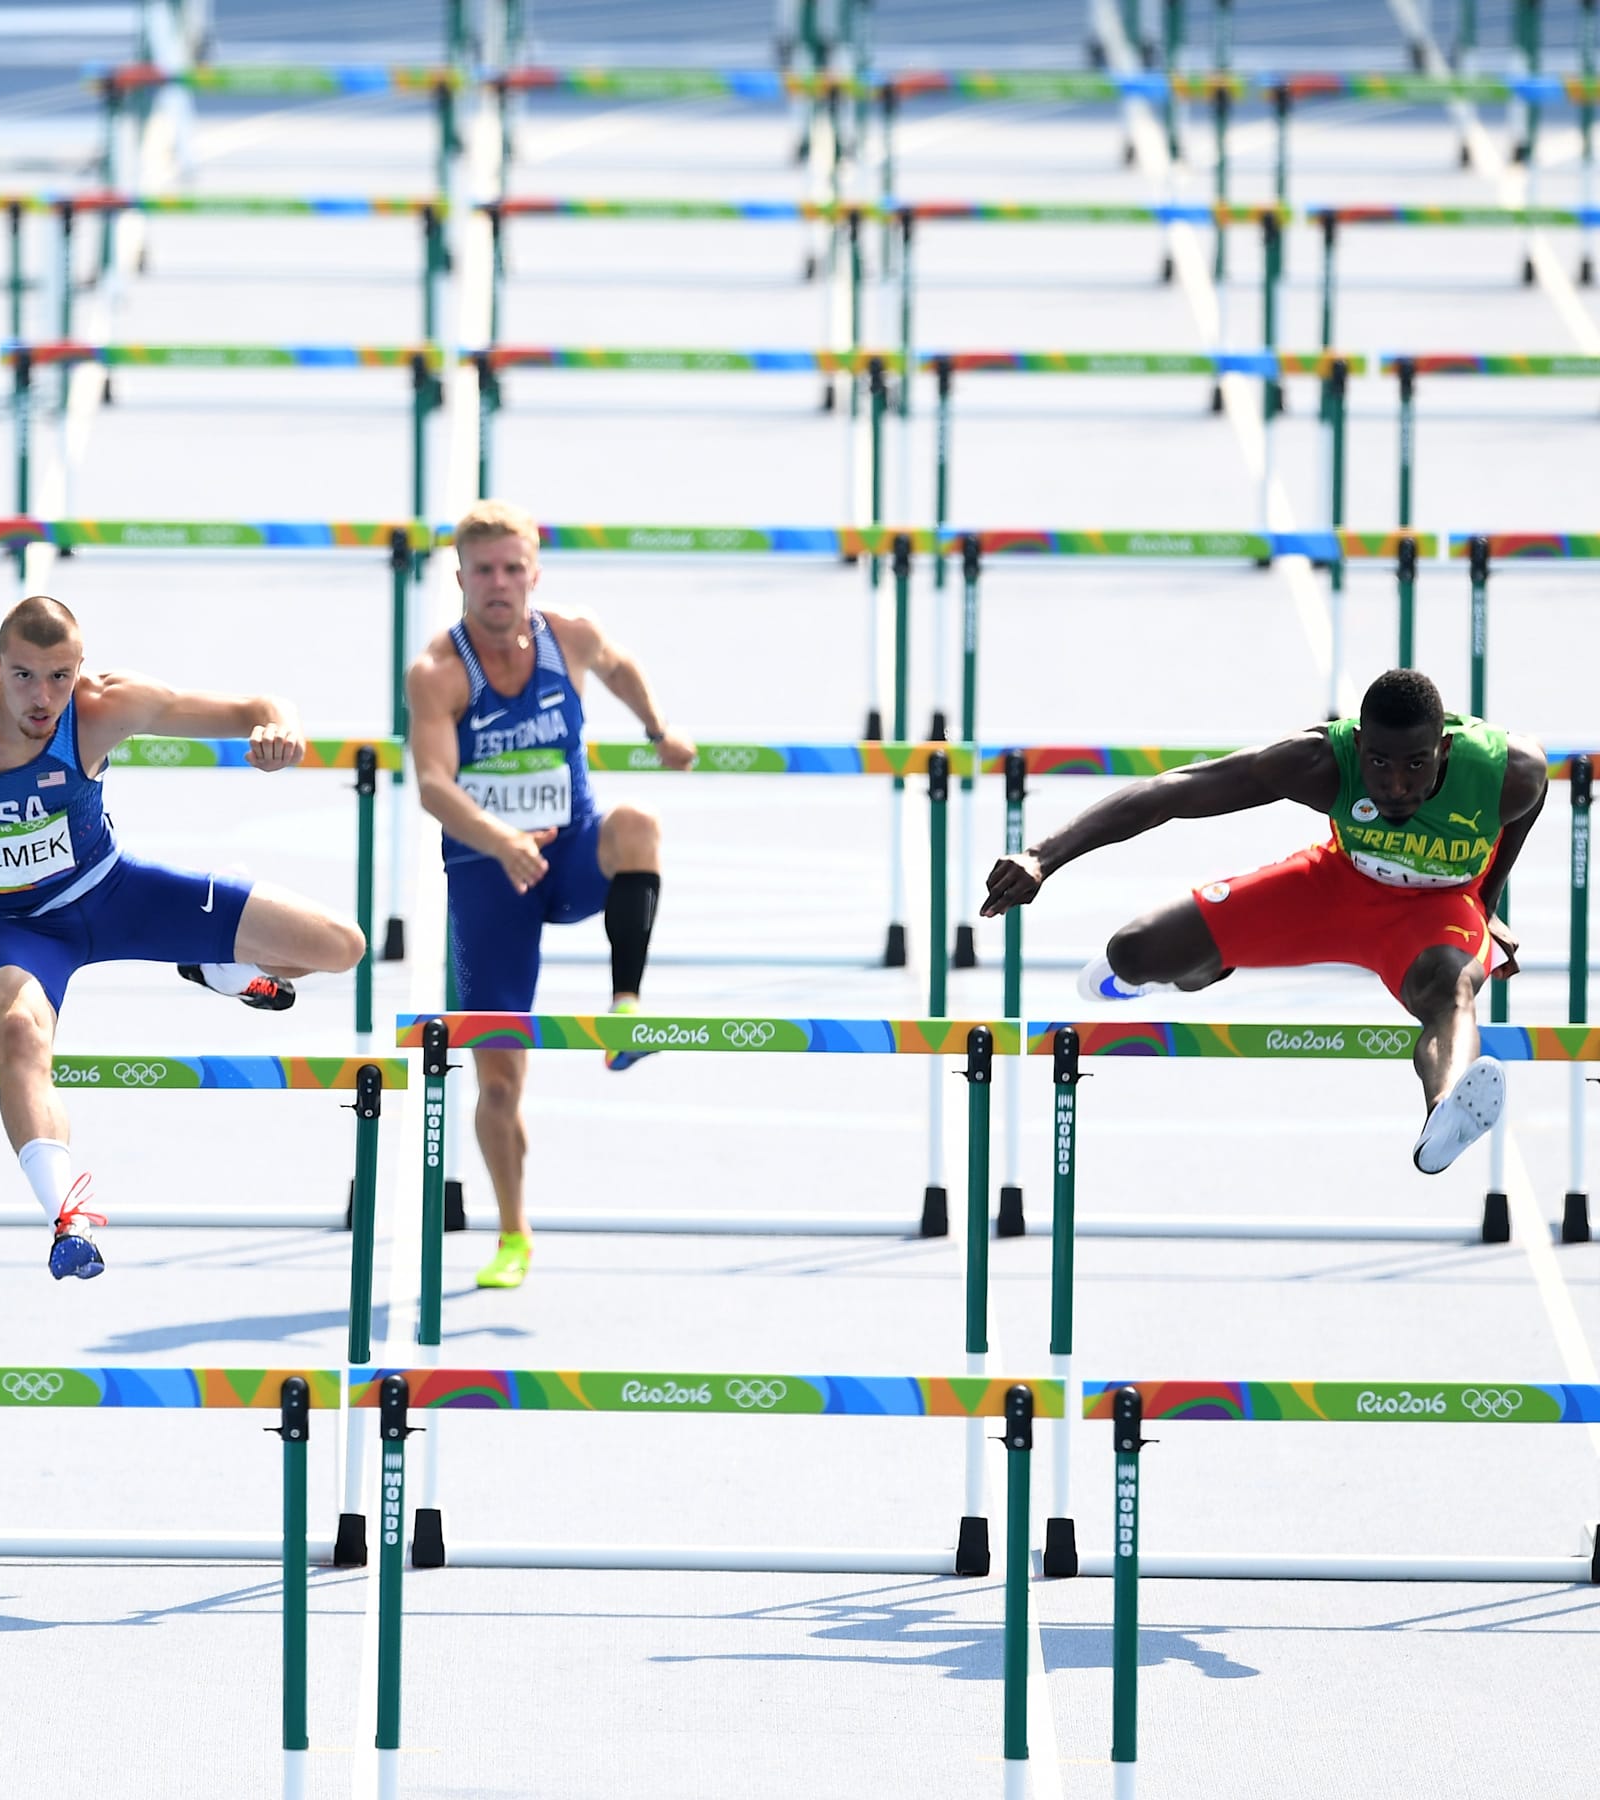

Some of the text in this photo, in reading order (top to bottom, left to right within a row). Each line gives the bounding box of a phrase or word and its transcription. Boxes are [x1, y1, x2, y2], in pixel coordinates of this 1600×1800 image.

[474, 710, 568, 760] ESTONIA
[632, 1023, 710, 1045] Rio2016
[1266, 1029, 1345, 1051] Rio2016
[51, 1064, 101, 1084] o2016
[426, 1103, 442, 1167] MONDO
[1057, 1110, 1073, 1175] MONDO
[621, 1379, 713, 1404] Rio2016
[1356, 1391, 1447, 1414] Rio2016
[383, 1473, 403, 1546] MONDO
[1118, 1484, 1137, 1558] MONDO
